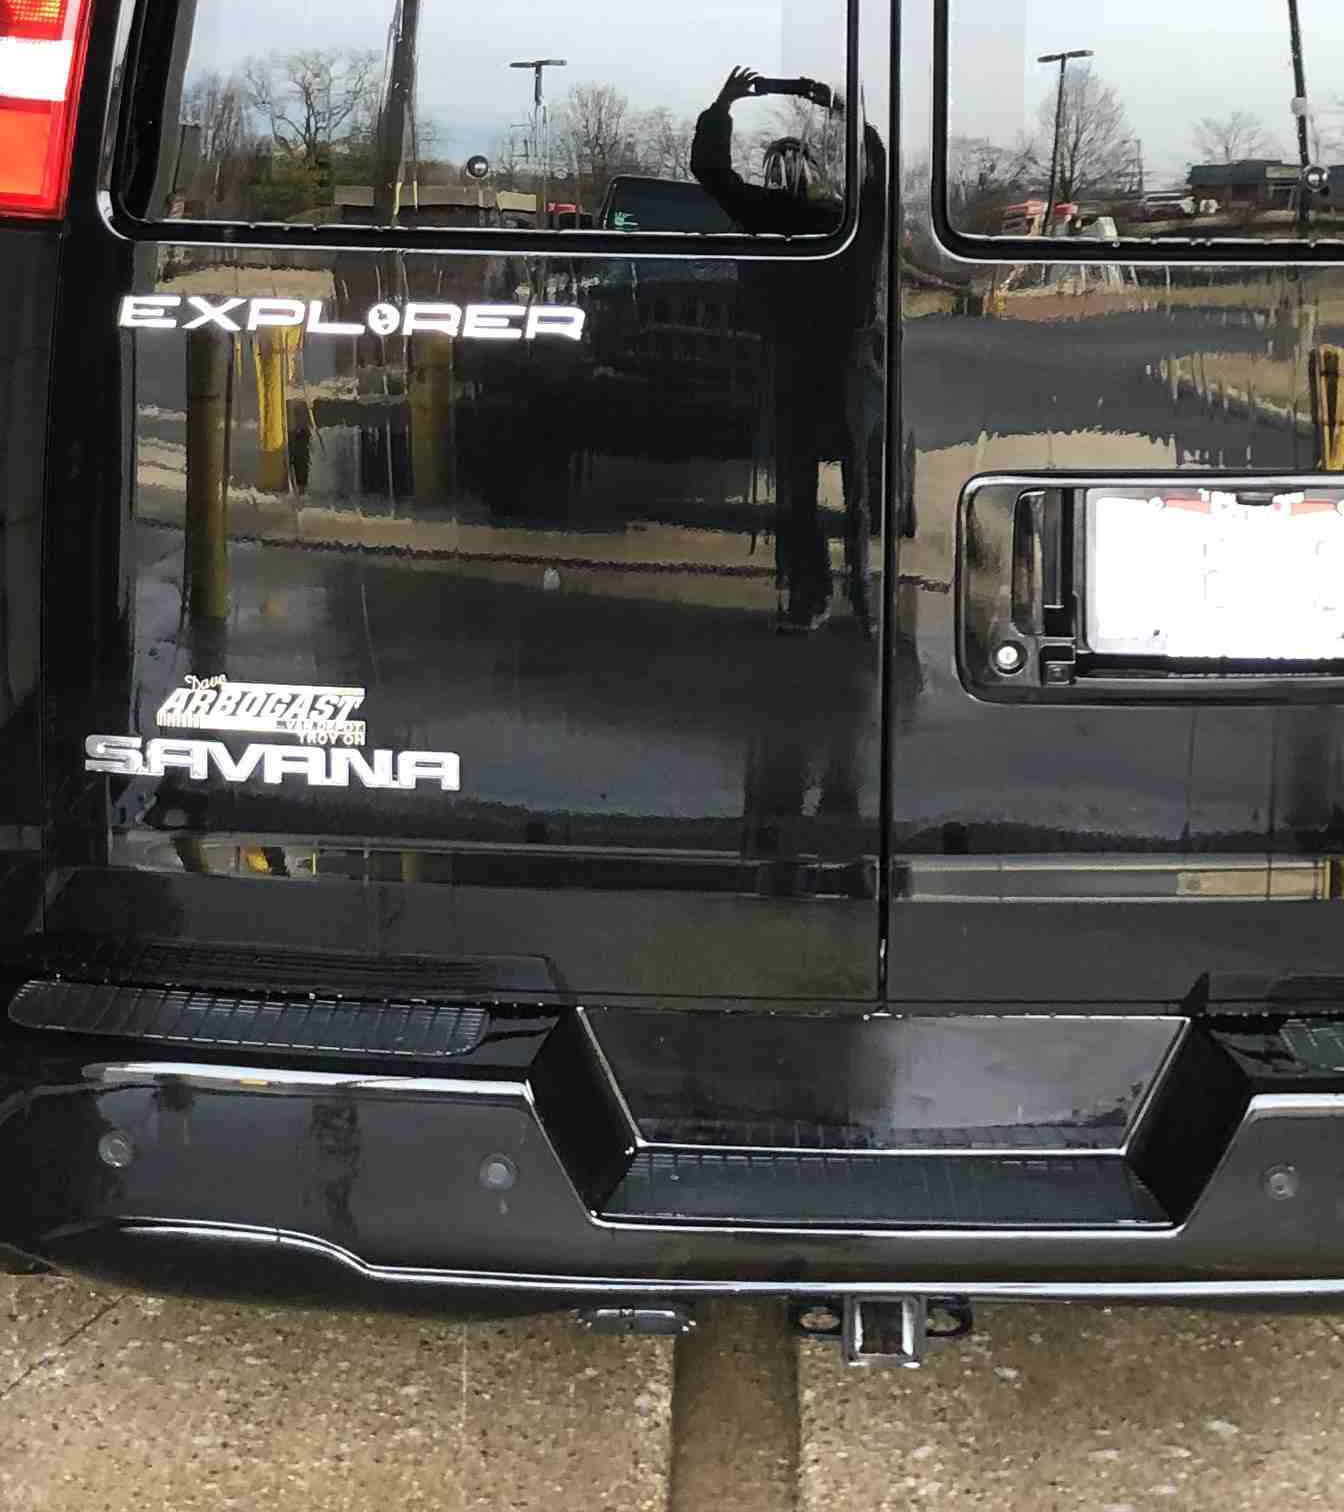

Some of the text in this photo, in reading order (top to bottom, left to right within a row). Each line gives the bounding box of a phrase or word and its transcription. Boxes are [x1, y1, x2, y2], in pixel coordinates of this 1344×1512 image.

[117, 294, 587, 341] EXPLORER
[157, 686, 366, 722] ARBOGAST
[84, 733, 462, 792] SAVANA
